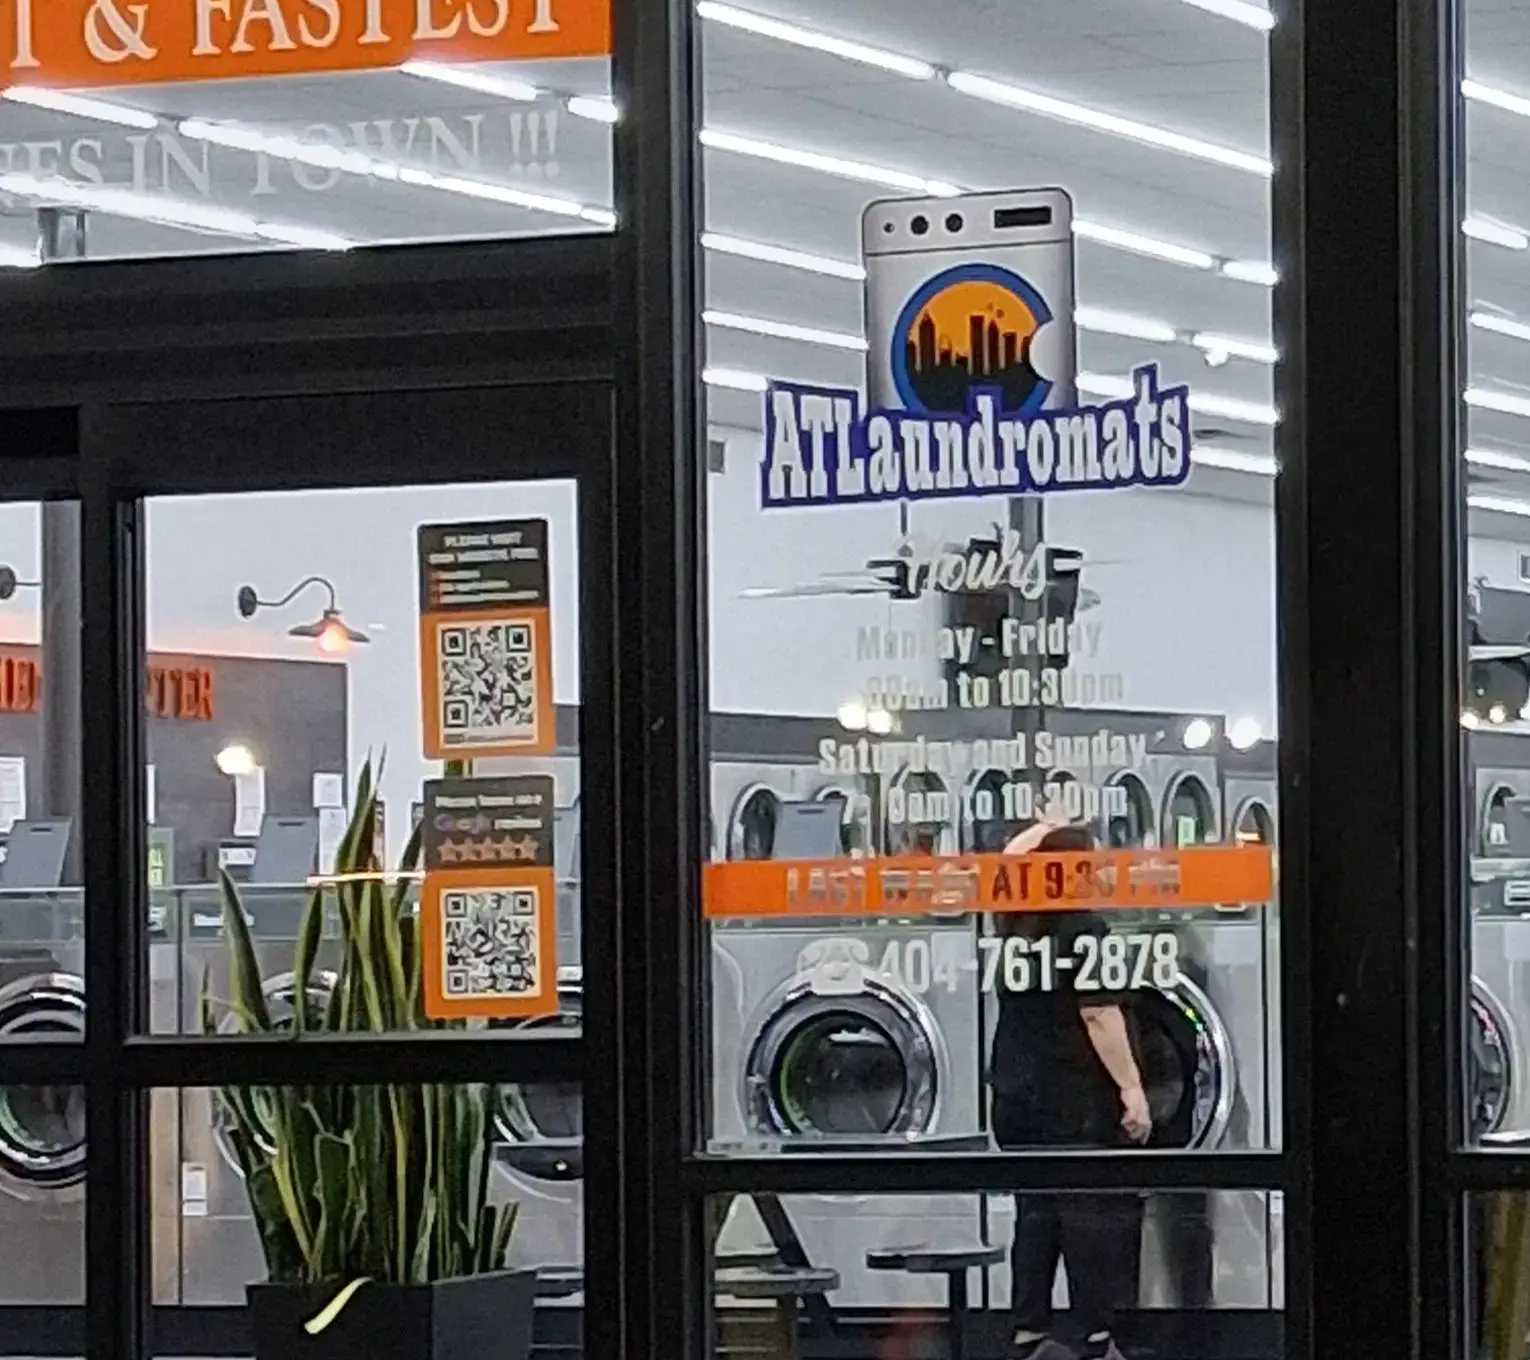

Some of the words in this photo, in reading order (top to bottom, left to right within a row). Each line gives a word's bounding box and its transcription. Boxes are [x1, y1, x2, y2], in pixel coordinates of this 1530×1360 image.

[125, 128, 211, 197] IN
[766, 366, 1190, 504] ATLaundromats
[958, 670, 990, 709] to
[992, 861, 1033, 901] AT
